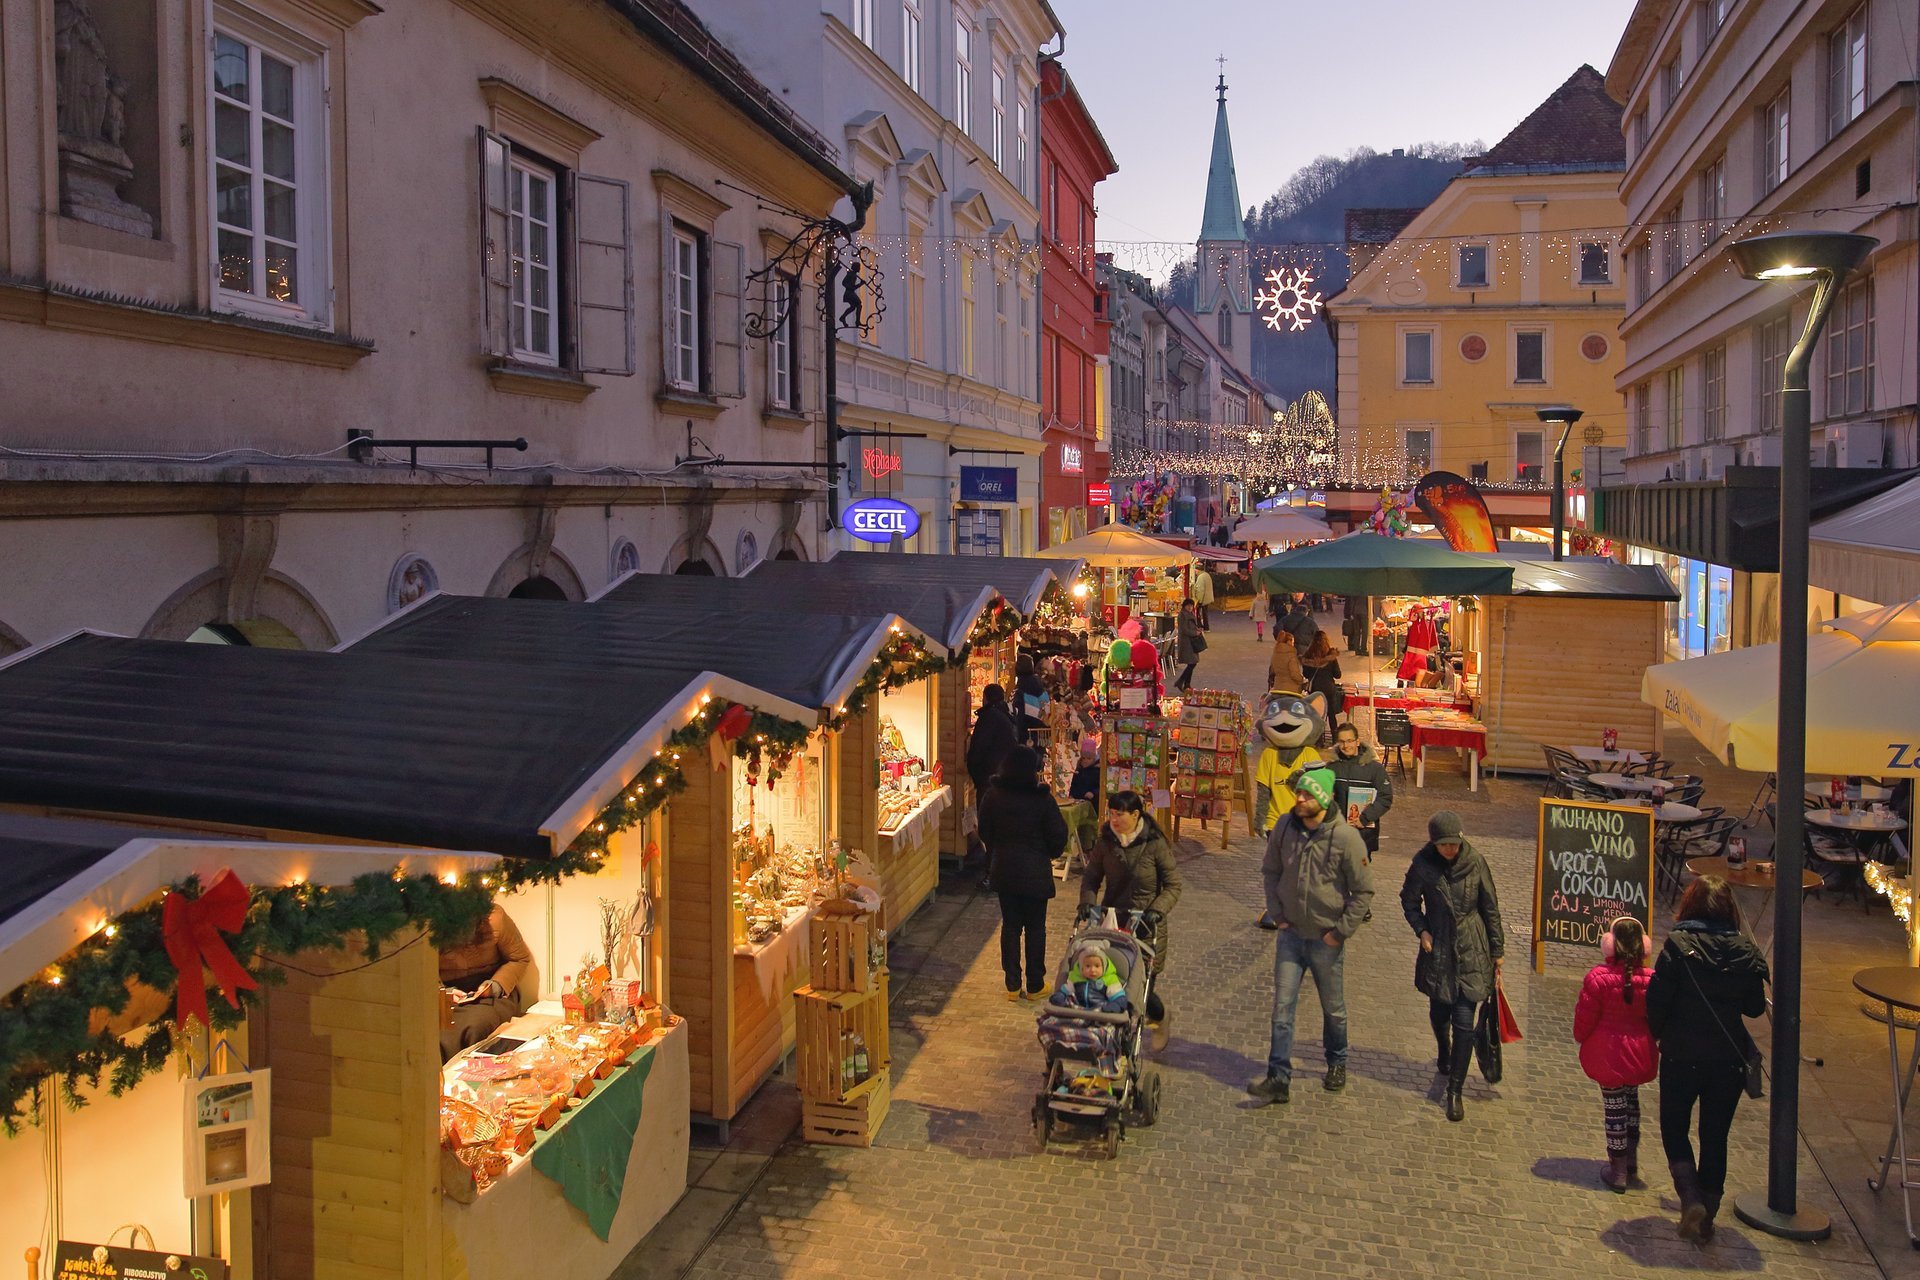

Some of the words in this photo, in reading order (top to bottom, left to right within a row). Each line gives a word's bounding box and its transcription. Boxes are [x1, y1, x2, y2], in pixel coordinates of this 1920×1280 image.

[863, 447, 902, 478] Stephanie
[980, 482, 1003, 492] OREL
[854, 512, 907, 529] CECIL
[1551, 807, 1624, 835] KUHANO
[1590, 834, 1635, 859] VINO
[1549, 848, 1608, 876] VROČA
[1551, 890, 1579, 913] ČAJ
[1561, 870, 1647, 908] ČOKOLADA
